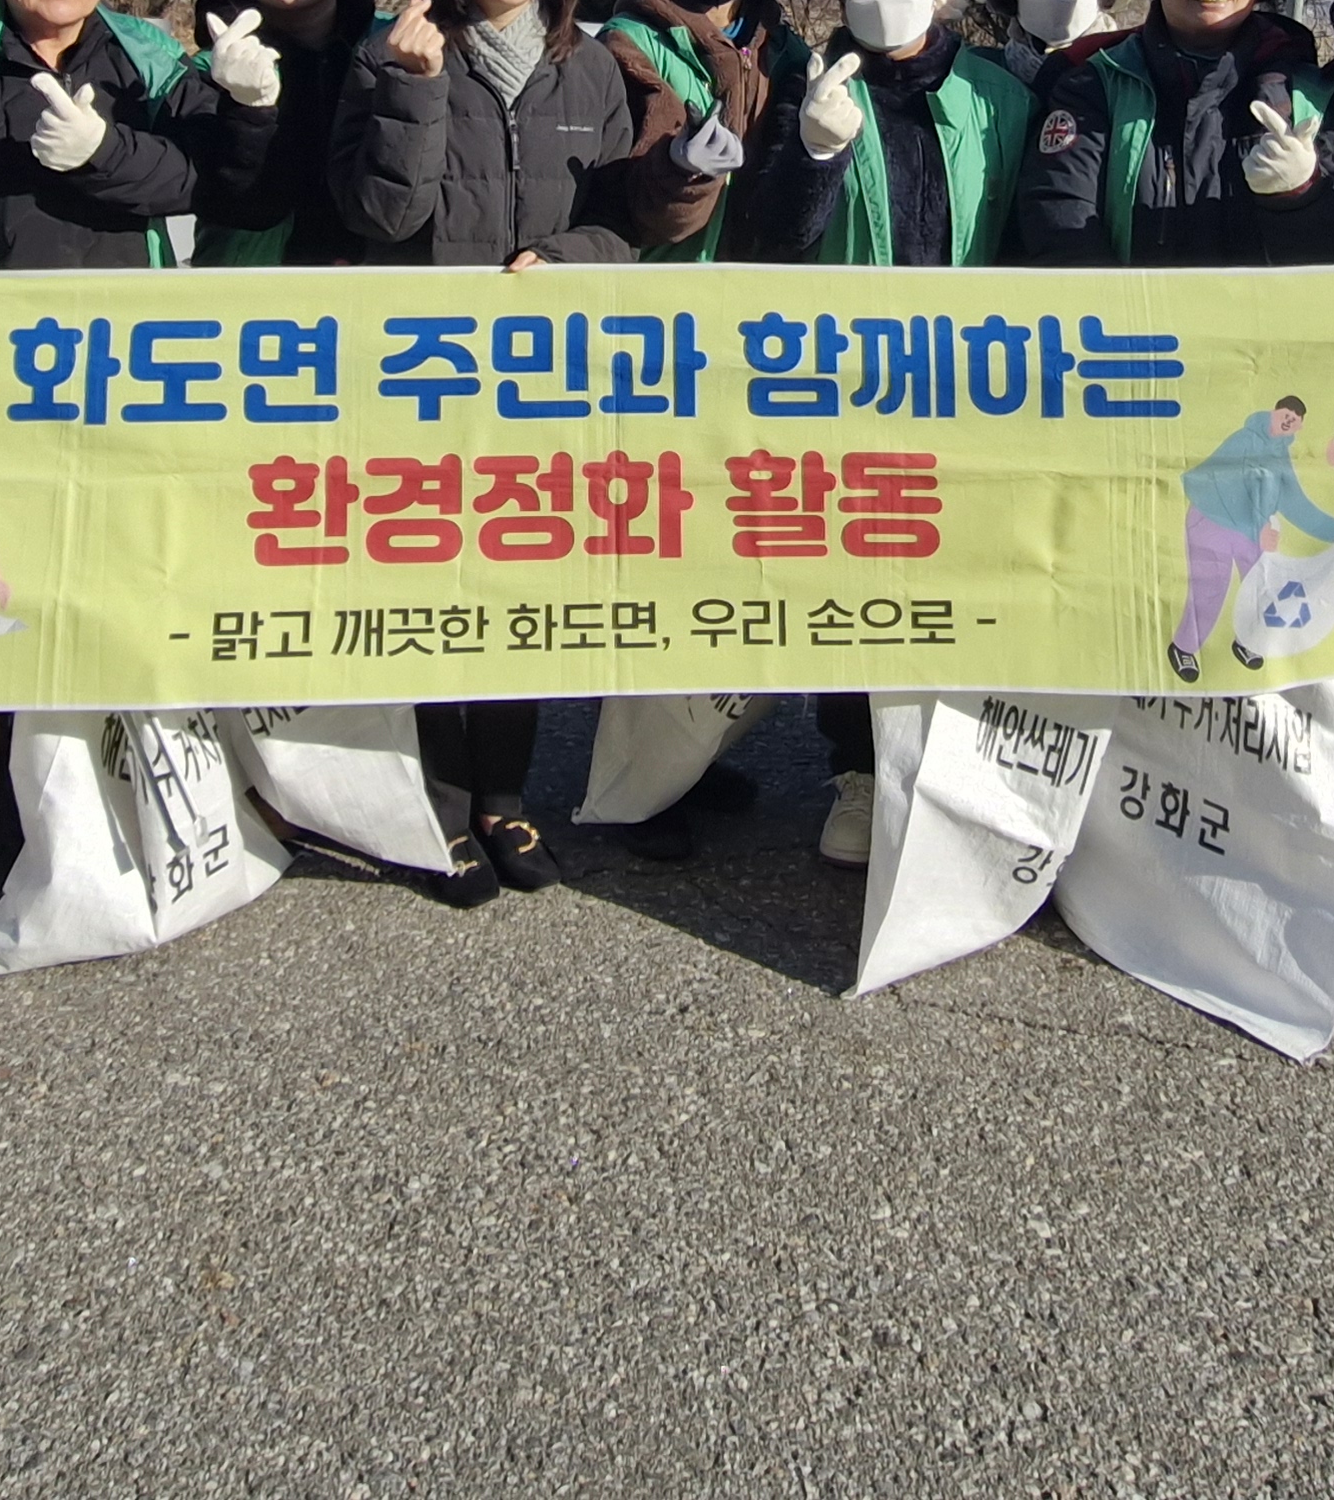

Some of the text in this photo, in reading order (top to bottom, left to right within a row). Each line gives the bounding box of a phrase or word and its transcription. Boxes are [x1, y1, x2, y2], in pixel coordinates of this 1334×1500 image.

[7, 312, 1184, 426] 화도면 주민과 함께하는
[247, 449, 942, 566] 환경정화 활동
[210, 611, 313, 661] 맑고
[331, 605, 490, 657] 깨끗한
[505, 601, 671, 652] 화도면,
[690, 598, 786, 647] 우리
[806, 598, 956, 646] 손으로
[975, 696, 1098, 796] 해안쓰레기
[1120, 765, 1230, 856] 강화군
